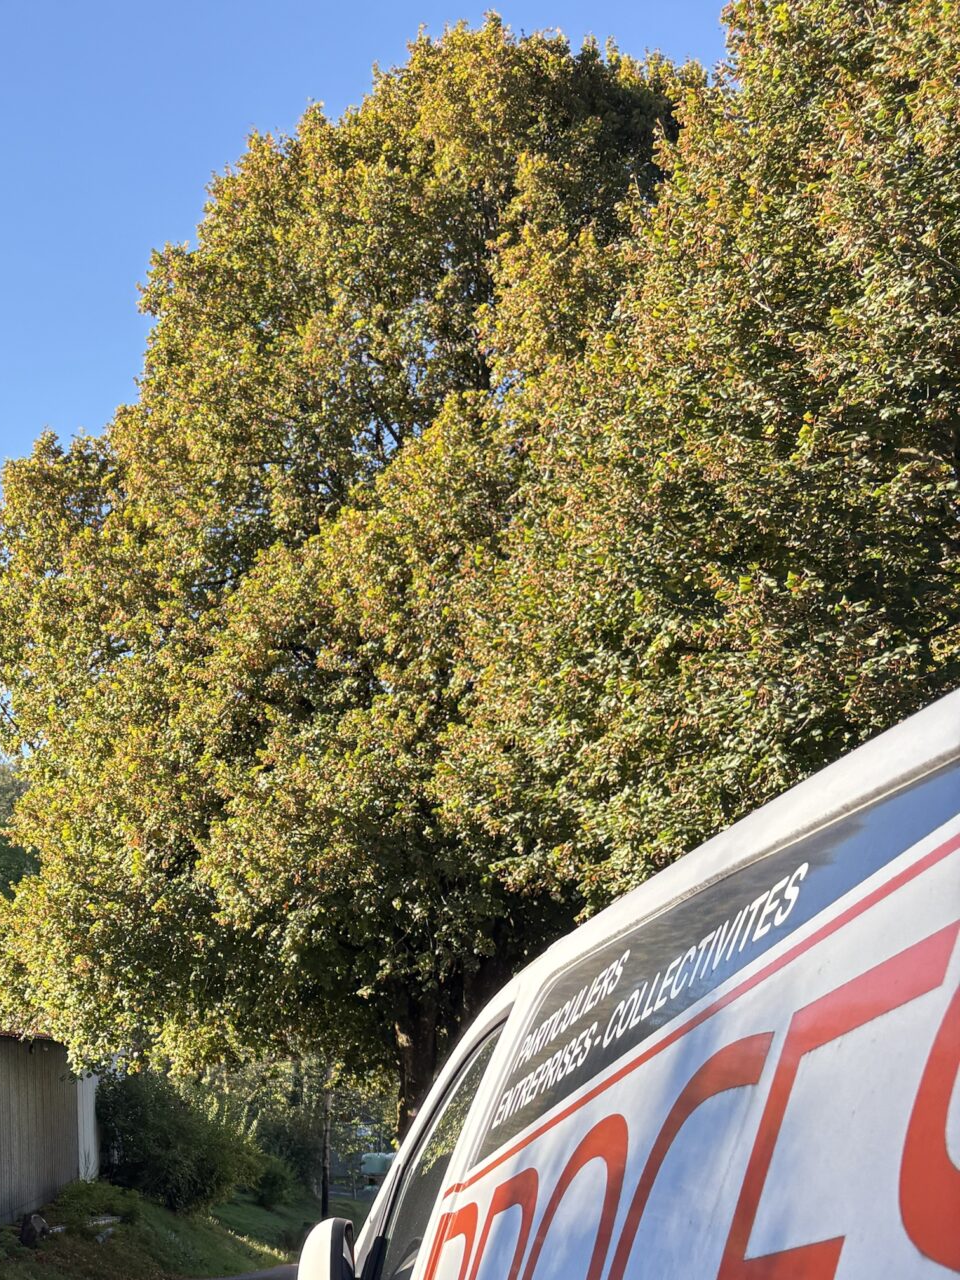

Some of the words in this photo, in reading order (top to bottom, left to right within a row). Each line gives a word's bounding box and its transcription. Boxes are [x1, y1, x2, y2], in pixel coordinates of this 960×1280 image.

[492, 1021, 598, 1129] ENTREPRISES
[602, 862, 809, 1048] COLLECTIVITES
[513, 949, 631, 1073] PARTICULIERS
